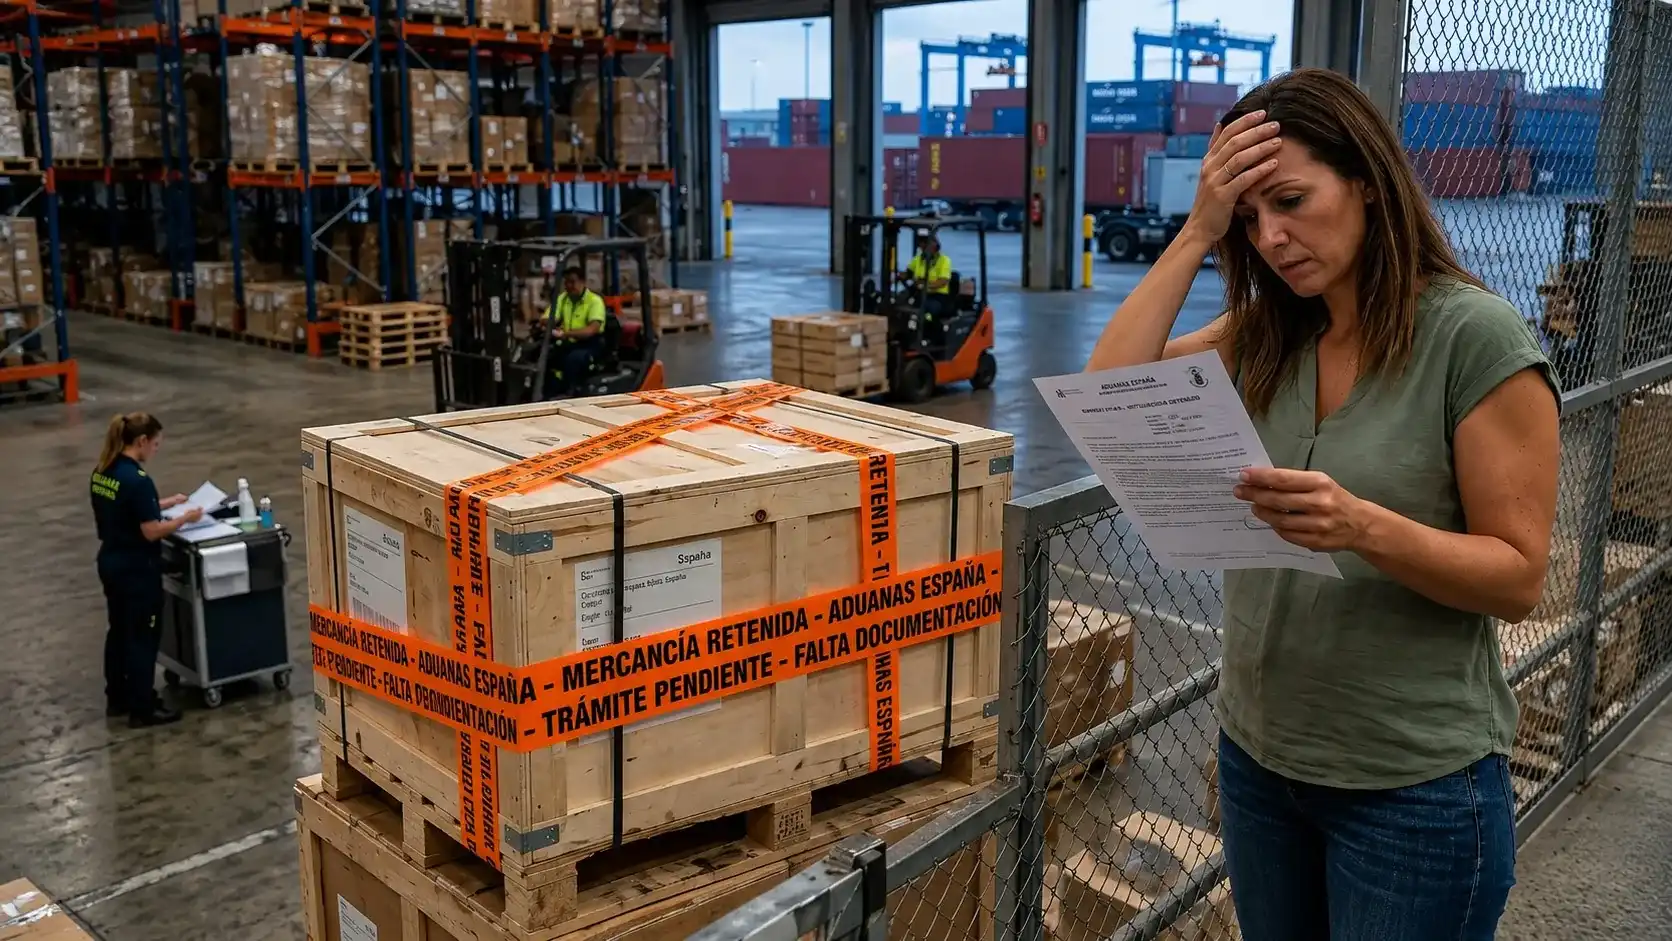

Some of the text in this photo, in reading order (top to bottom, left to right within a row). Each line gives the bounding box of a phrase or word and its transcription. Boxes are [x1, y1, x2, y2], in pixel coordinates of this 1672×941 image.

[360, 630, 409, 667] RETENIDA
[418, 650, 471, 689] ADUANAS
[474, 667, 537, 704] ESPAÑA
[562, 630, 700, 693] MERCANCÍA
[707, 607, 808, 655] RETENIDA
[828, 579, 915, 625] ADUANAS
[921, 560, 986, 600] ESPAÑA
[383, 671, 413, 704] FALTA
[541, 685, 647, 737] TRÁMITE
[654, 651, 772, 708] PENDIENTE
[794, 632, 850, 669] FALTA
[856, 589, 1002, 651] DOCUMENTACIÓN
